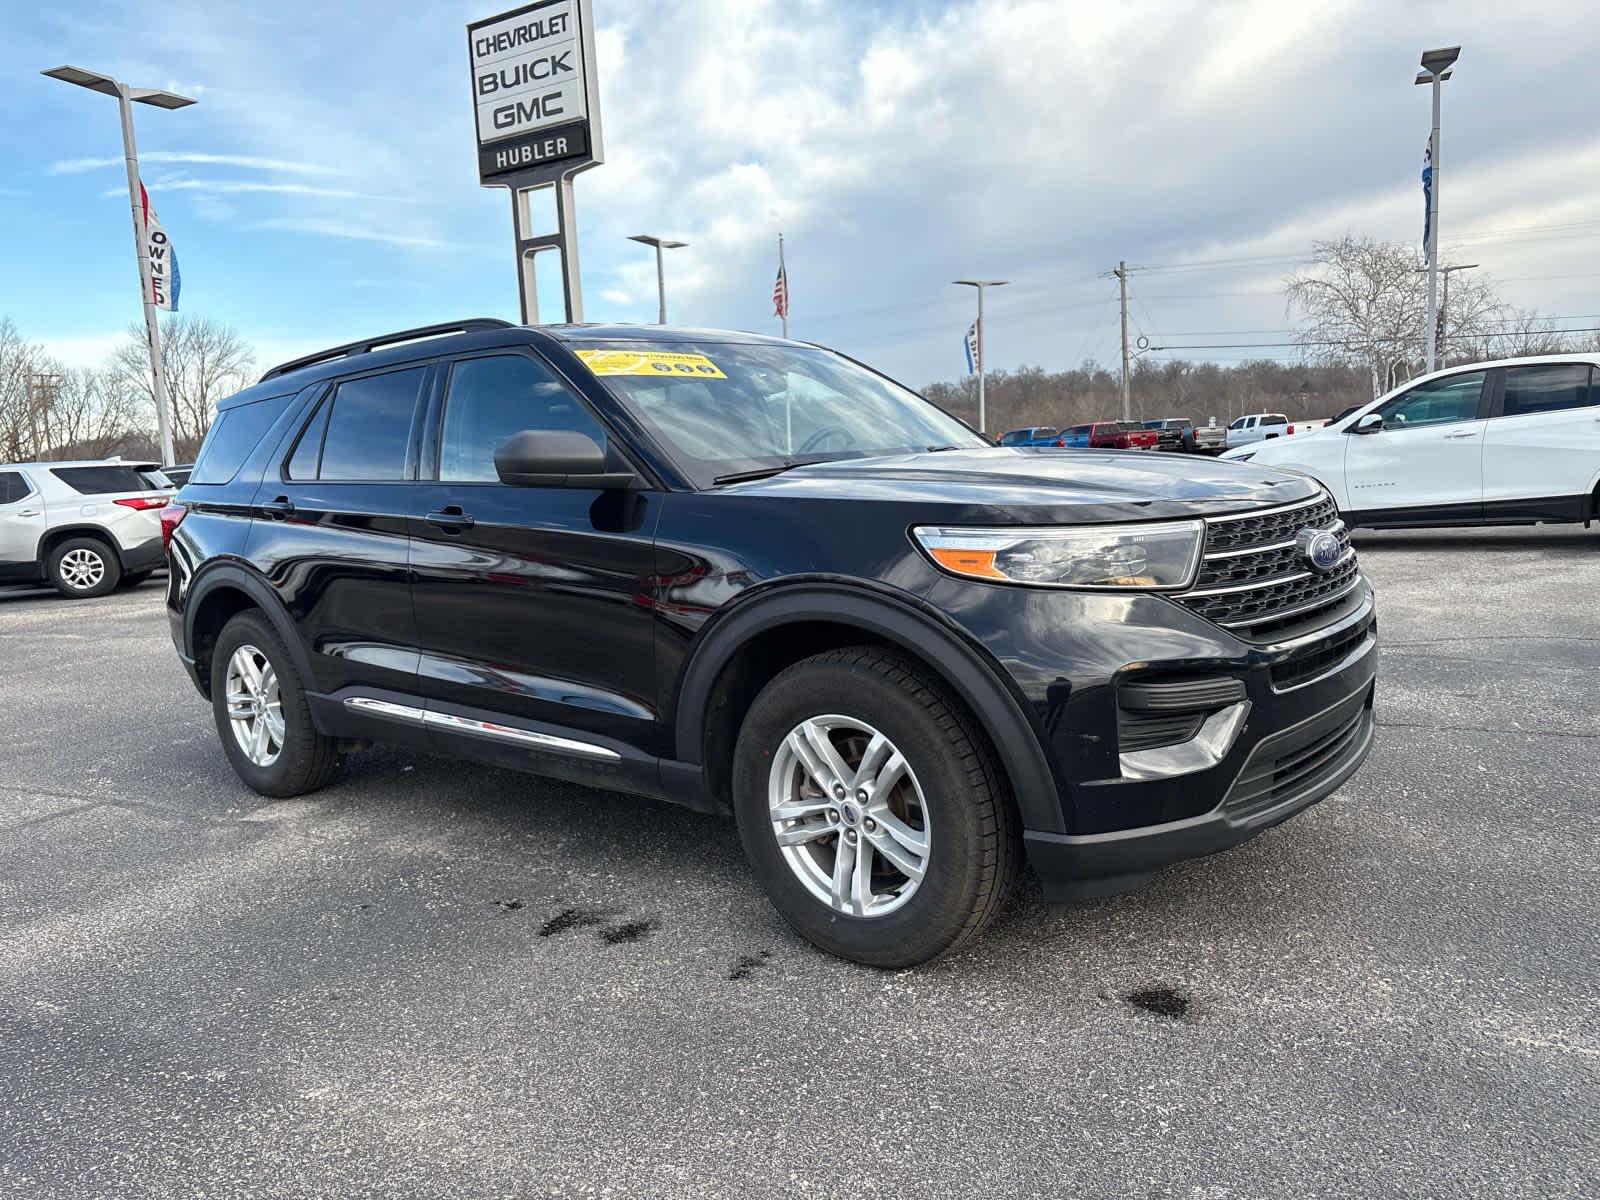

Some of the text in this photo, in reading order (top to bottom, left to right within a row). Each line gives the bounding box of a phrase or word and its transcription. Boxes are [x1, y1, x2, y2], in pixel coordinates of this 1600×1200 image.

[476, 13, 568, 57] CHEVROLET
[479, 51, 573, 95] BUICK
[494, 91, 564, 129] GMC
[496, 138, 568, 168] HUBLER
